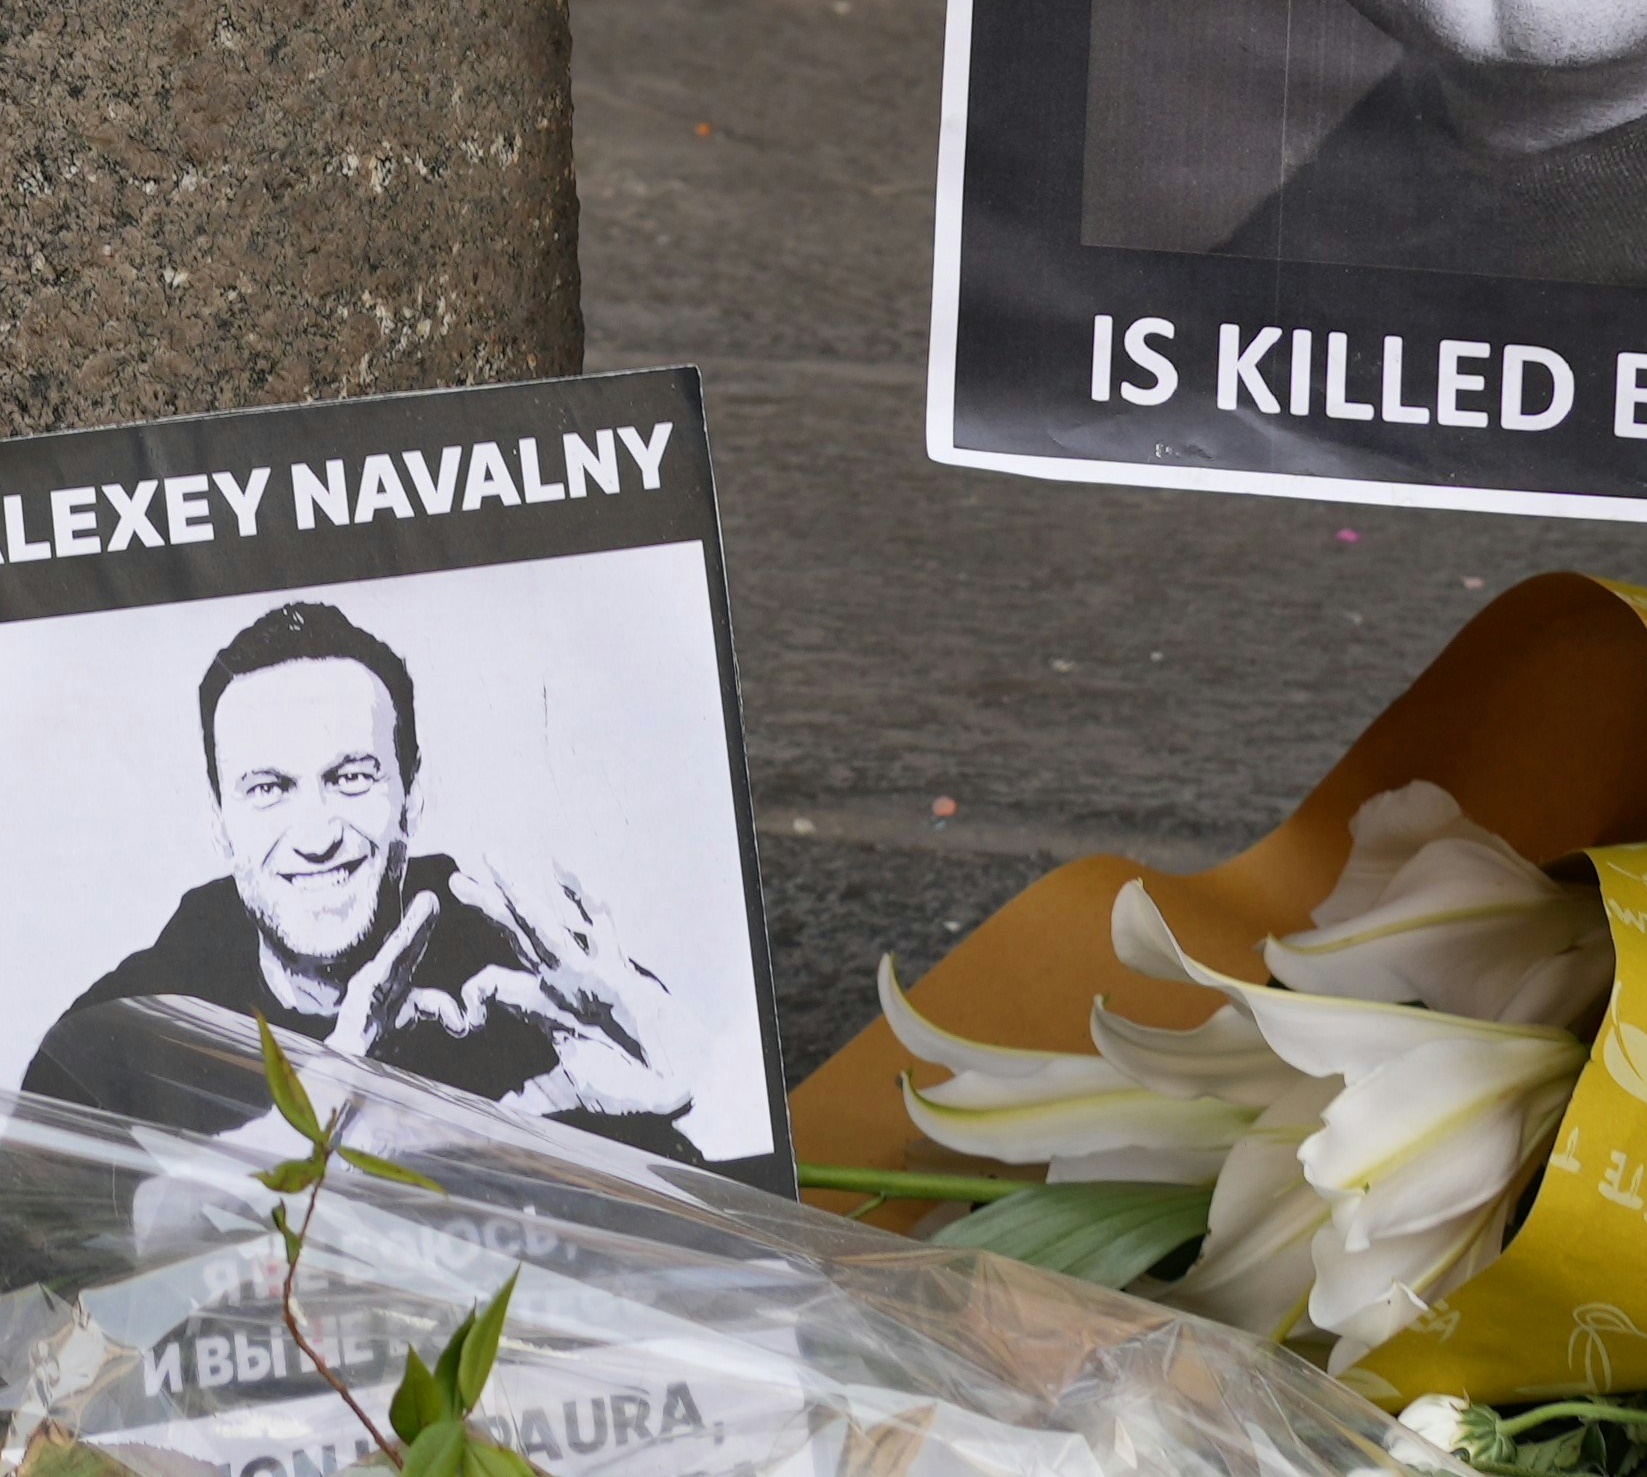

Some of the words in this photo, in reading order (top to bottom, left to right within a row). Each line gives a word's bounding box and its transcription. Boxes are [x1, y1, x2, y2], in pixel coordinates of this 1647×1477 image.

[1092, 315, 1178, 405] IS
[1215, 323, 1576, 432] KILLED
[291, 422, 674, 531] NAVALNY
